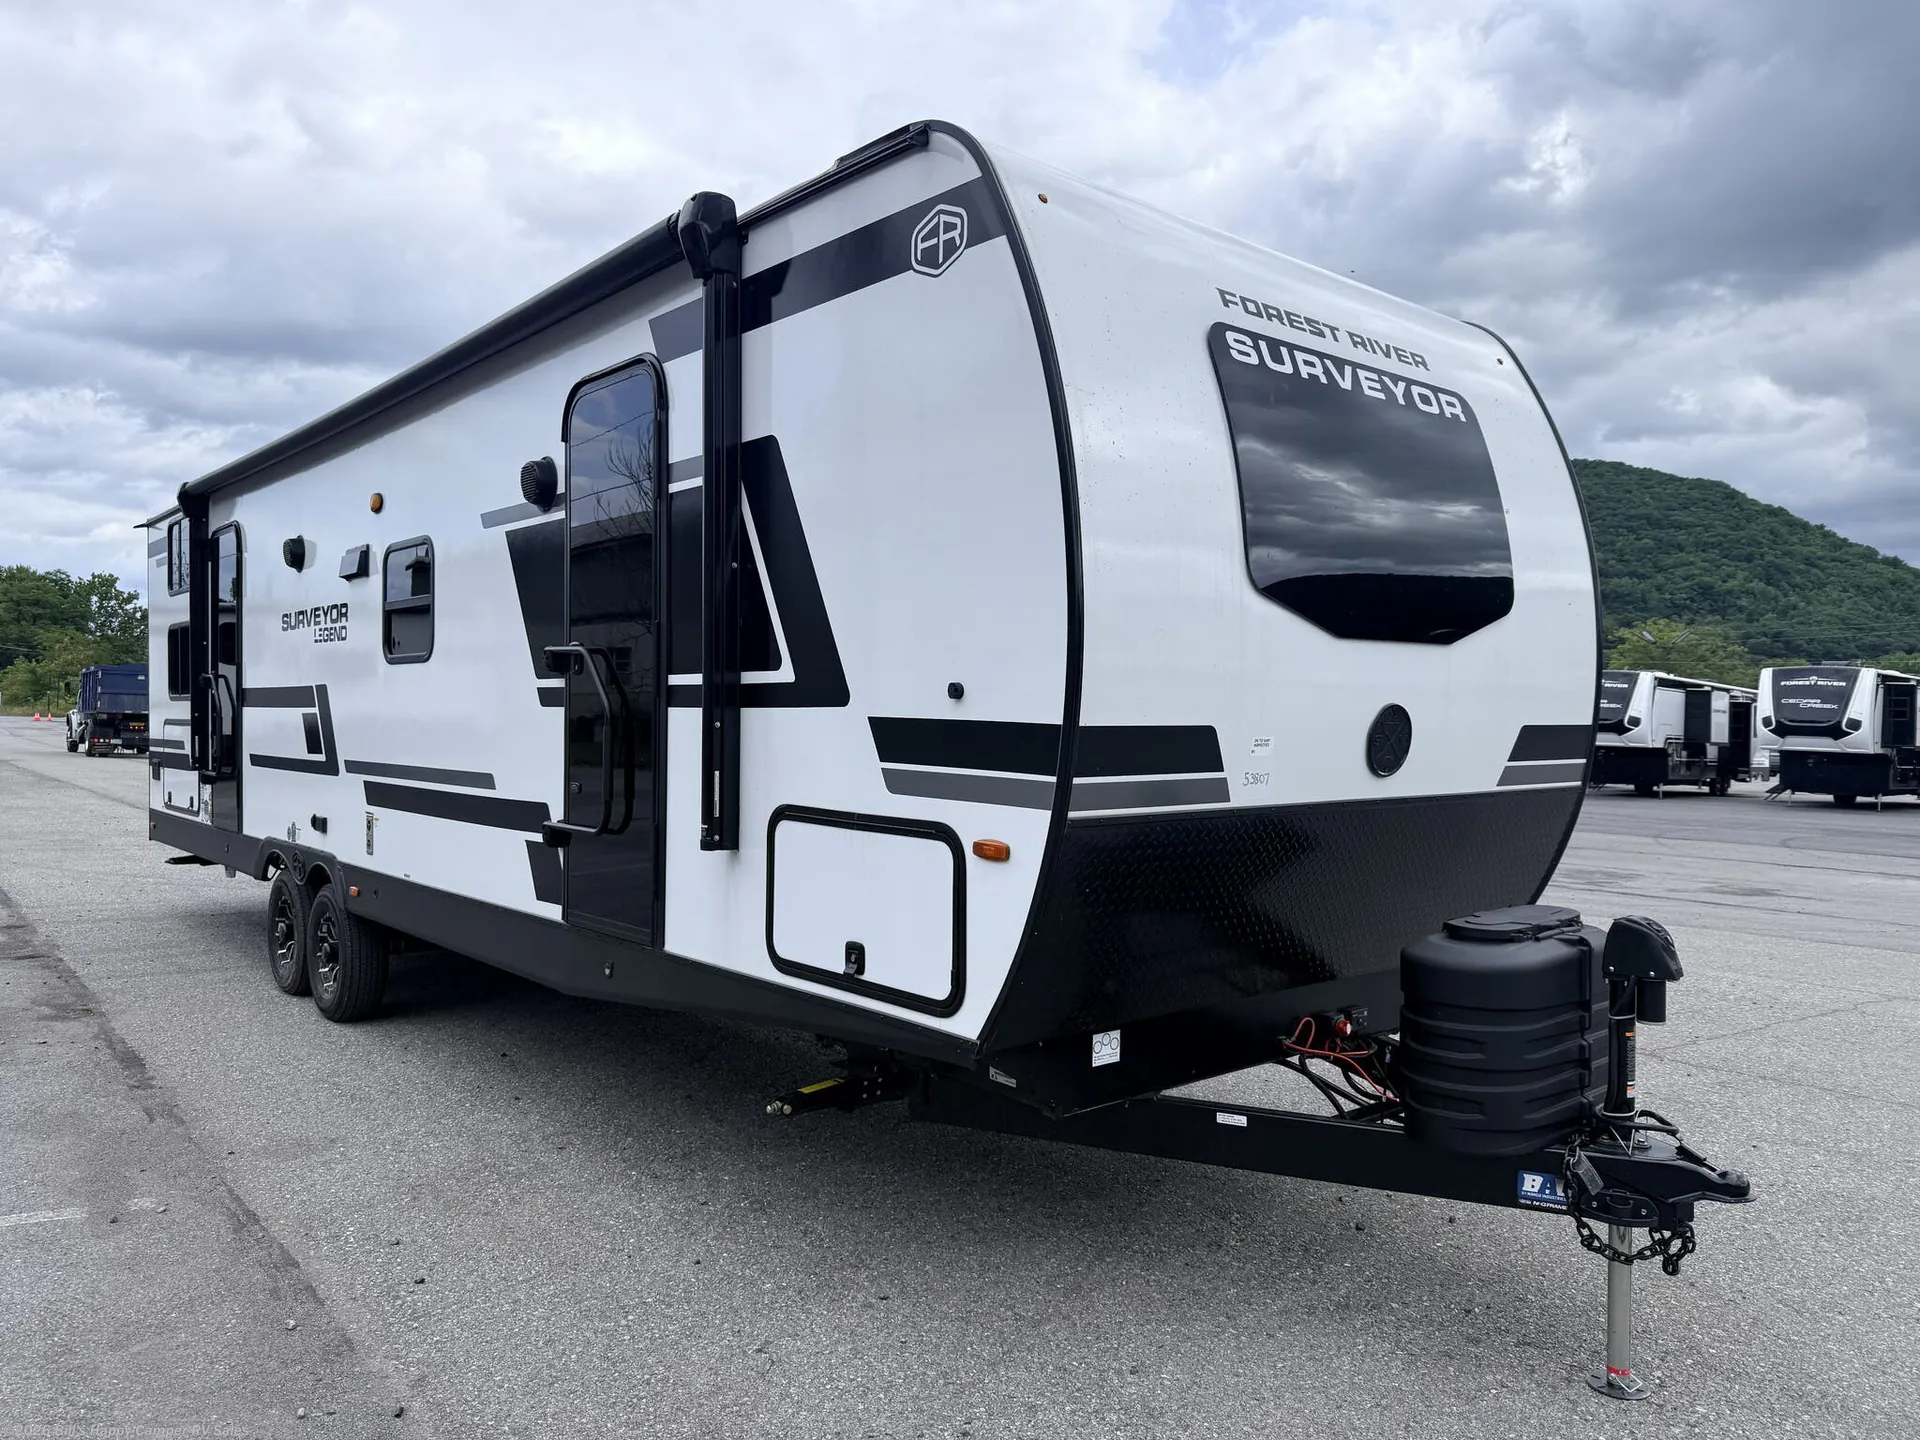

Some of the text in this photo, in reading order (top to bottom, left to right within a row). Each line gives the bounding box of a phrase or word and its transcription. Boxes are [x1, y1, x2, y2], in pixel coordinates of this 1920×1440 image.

[1215, 286, 1431, 372] FOREST RIVER
[1225, 330, 1467, 422] SURVEYOR
[281, 602, 349, 632] SURVEYOR
[313, 625, 348, 643] LEGEND
[1242, 771, 1270, 787] 53807
